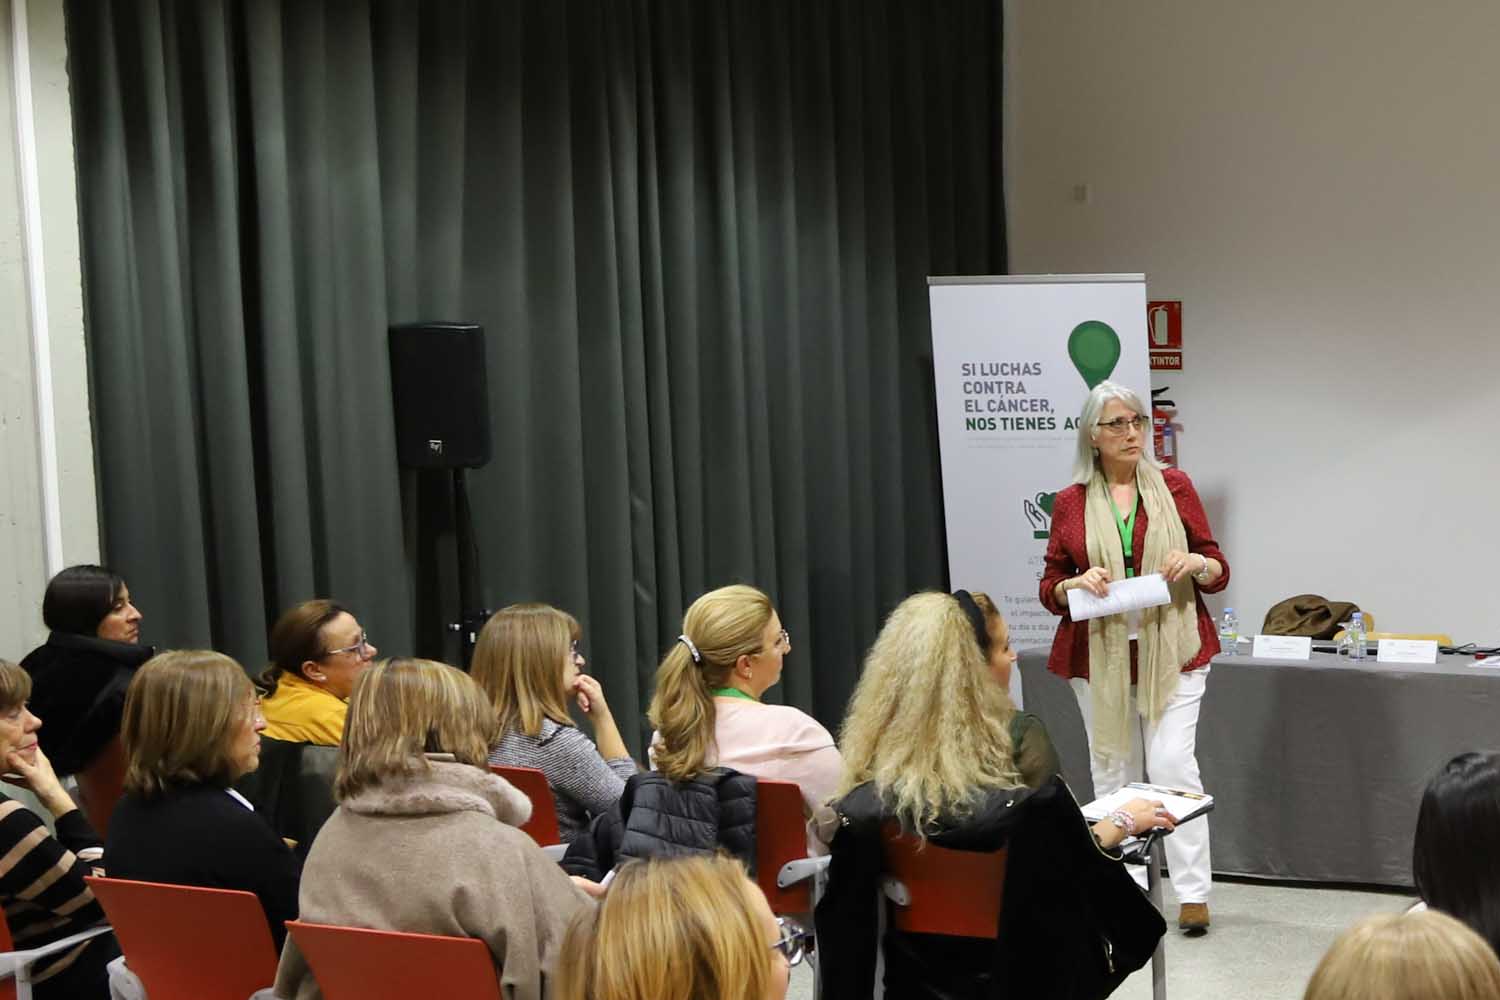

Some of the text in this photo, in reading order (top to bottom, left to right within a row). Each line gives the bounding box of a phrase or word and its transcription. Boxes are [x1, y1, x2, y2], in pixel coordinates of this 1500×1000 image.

[1151, 355, 1180, 367] TINTOR
[961, 362, 1042, 376] SI LUCHAS
[963, 381, 1027, 394] CONTRA
[964, 395, 1055, 414] EL CÁNCER,
[966, 417, 997, 431] NOS
[1000, 417, 1057, 431] TIENES
